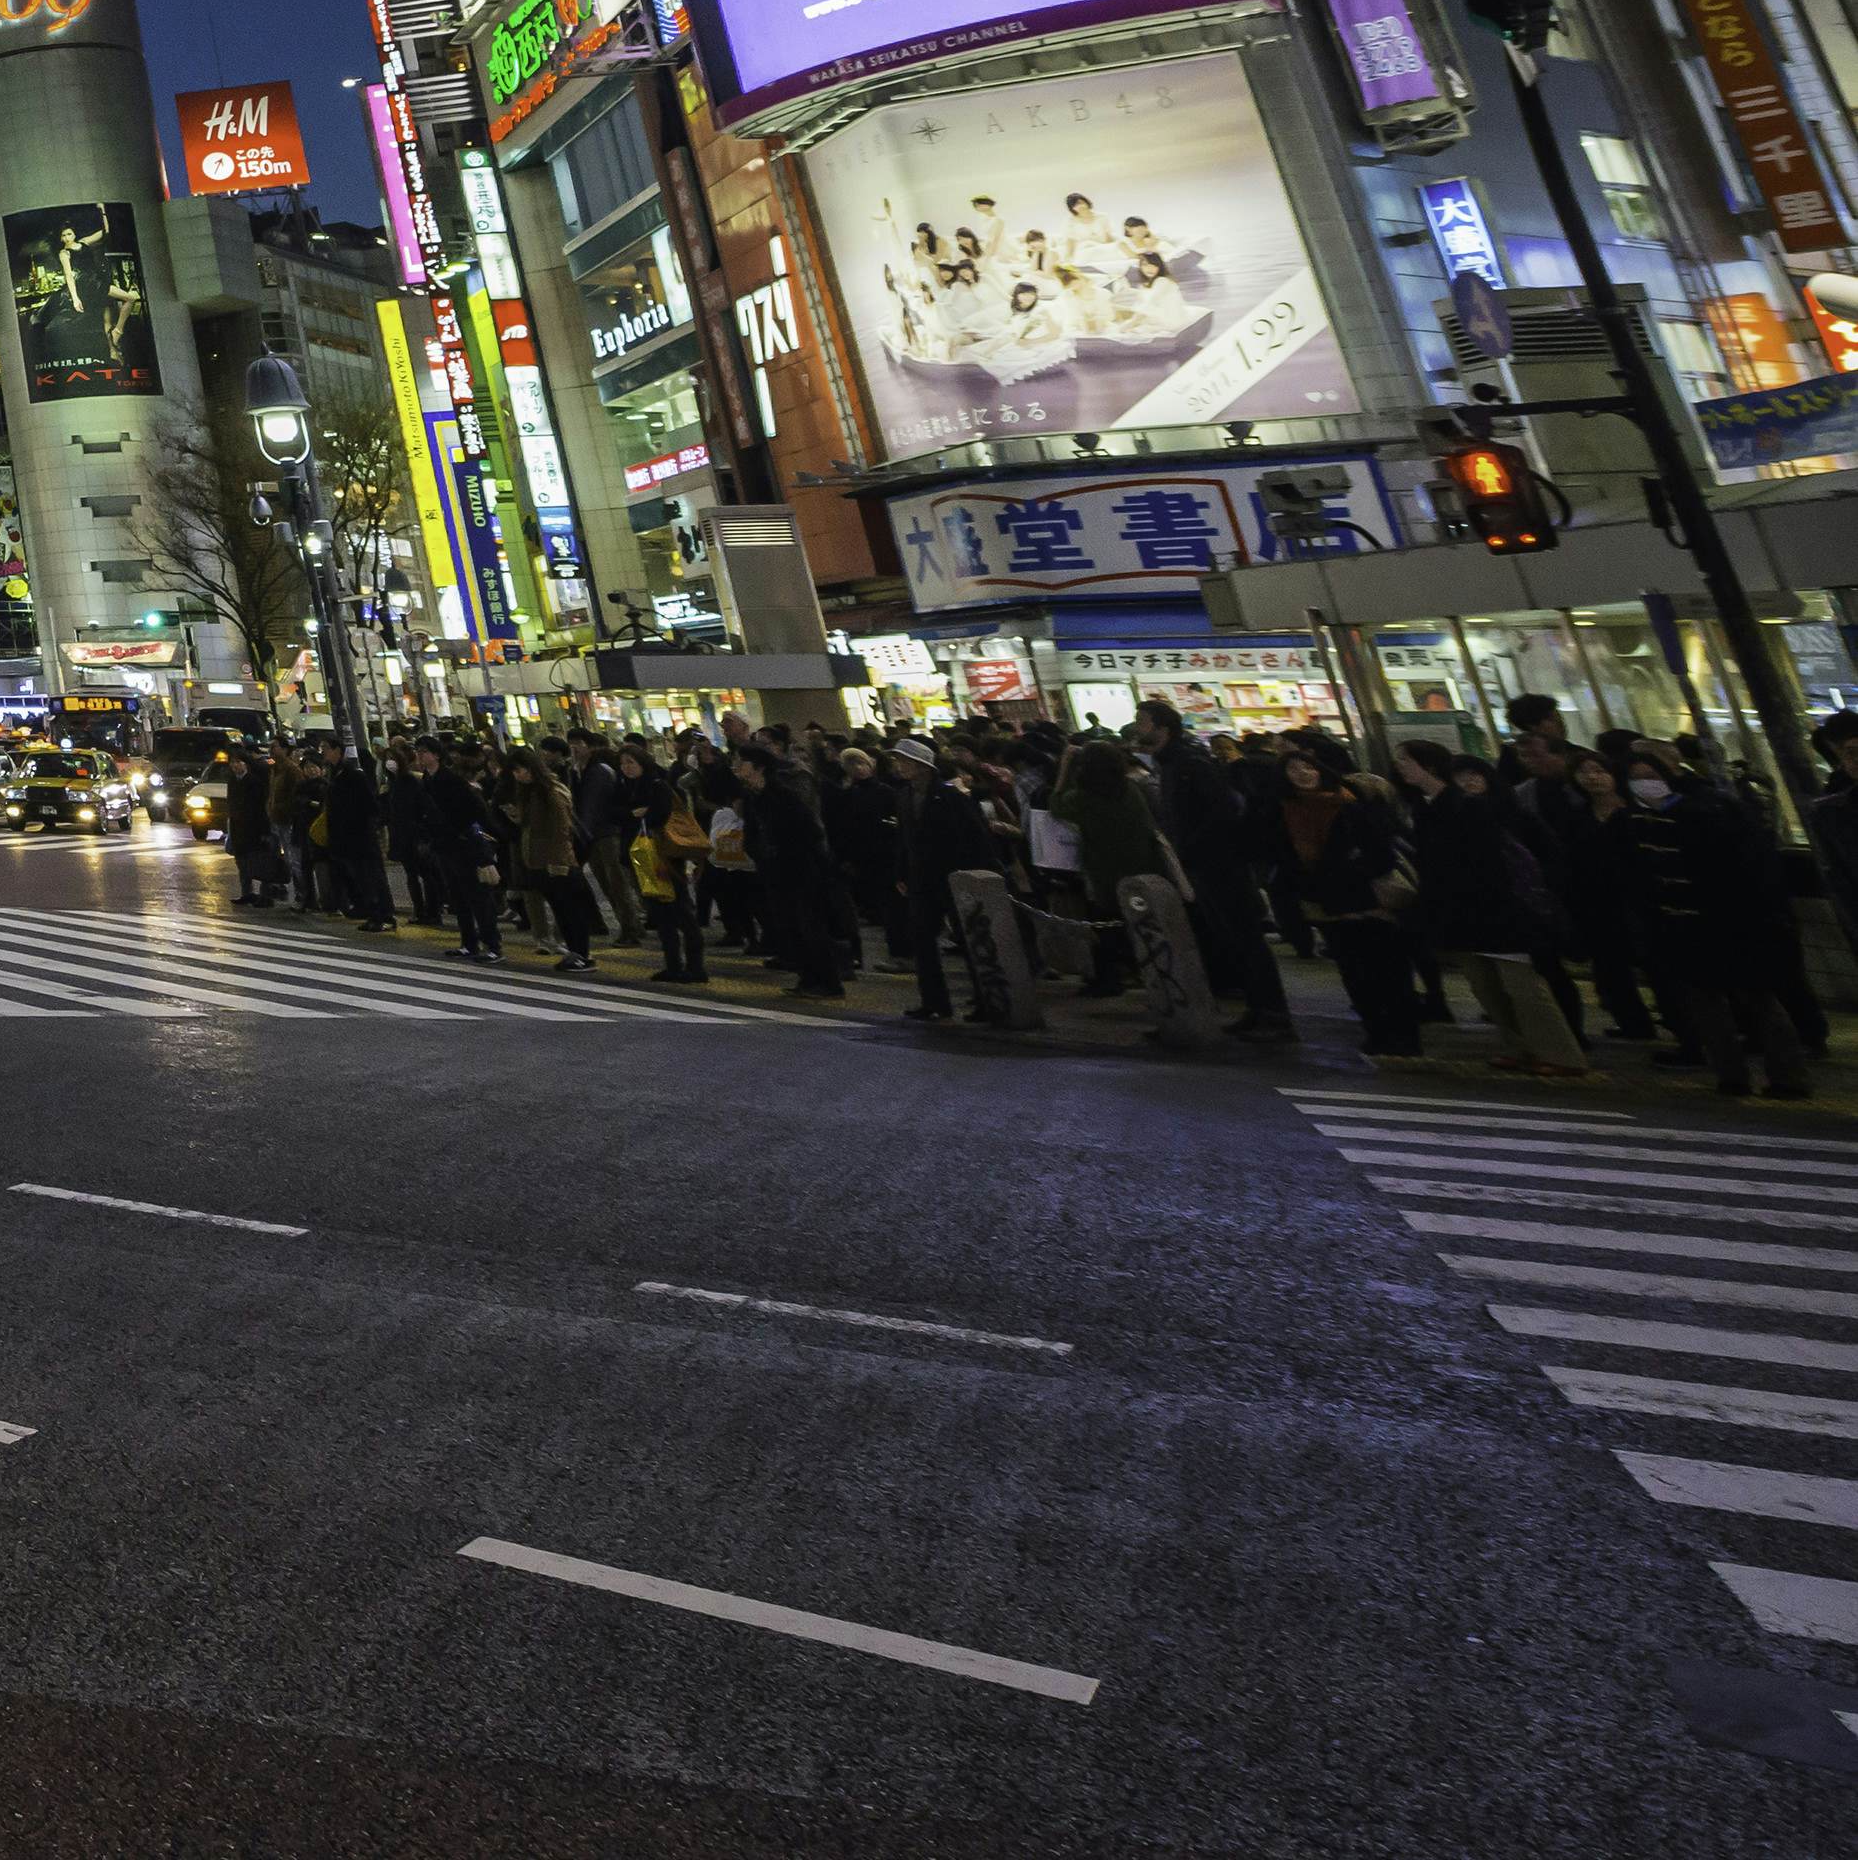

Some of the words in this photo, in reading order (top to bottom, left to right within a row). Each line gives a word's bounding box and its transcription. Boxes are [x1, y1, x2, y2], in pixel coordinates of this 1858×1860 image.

[808, 59, 866, 85] WAKASA
[870, 41, 939, 69] SEIKATSU
[944, 20, 1030, 50] CHANNEL
[203, 95, 270, 142] H&M
[234, 145, 276, 162] この先
[236, 157, 292, 179] 150m
[1728, 84, 1834, 230] 三千里
[591, 301, 671, 359] Euphoria
[35, 368, 149, 387] KATE
[404, 385, 423, 460] Matsumoto
[464, 475, 487, 528] MIZUHO
